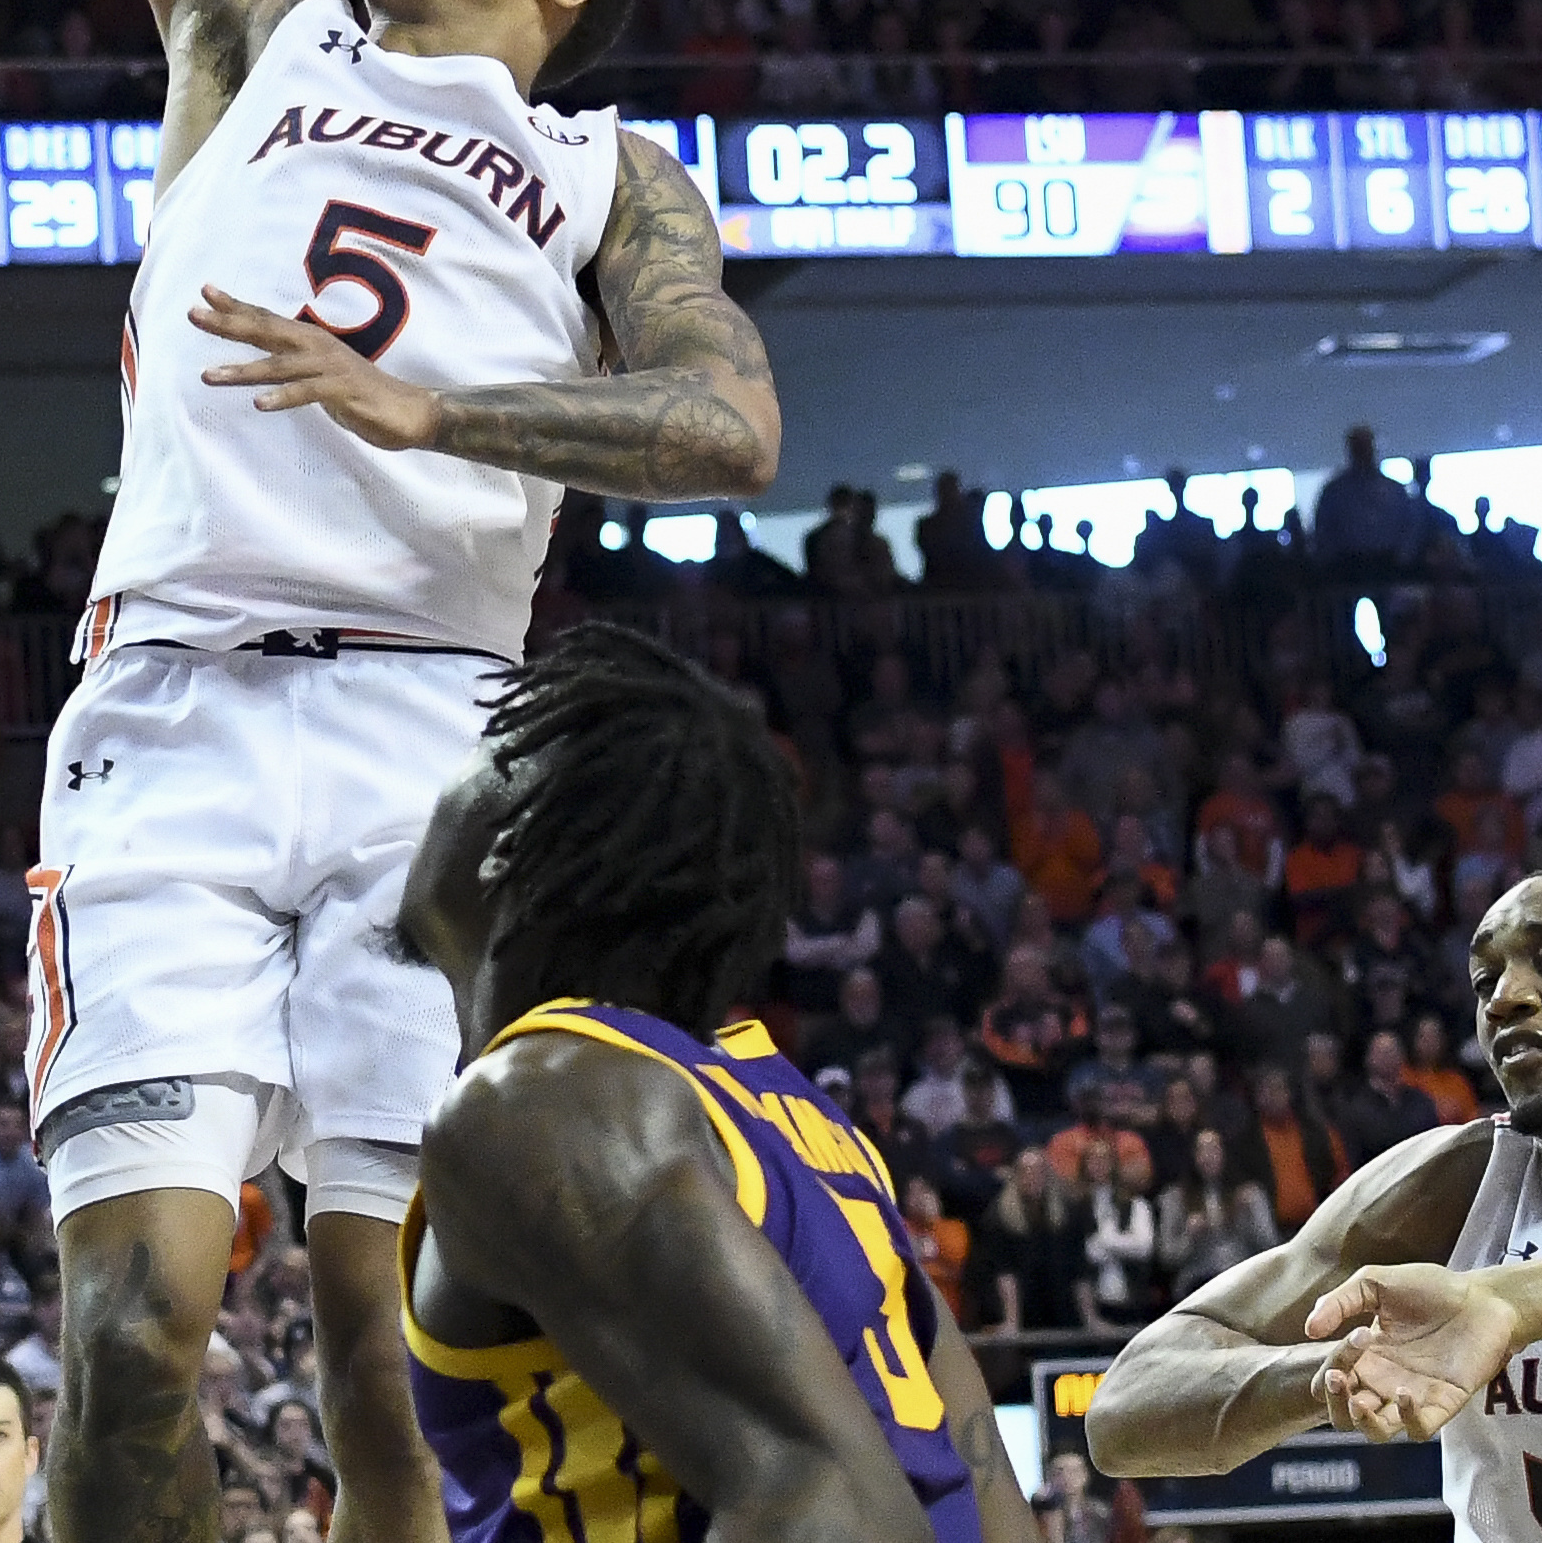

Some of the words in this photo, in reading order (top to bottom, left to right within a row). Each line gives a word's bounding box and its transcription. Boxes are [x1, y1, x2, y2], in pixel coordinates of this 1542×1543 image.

[248, 104, 567, 250] AUBURN
[746, 122, 918, 206] 02.2
[1266, 168, 1315, 236] 2
[1364, 167, 1416, 235] 6
[8, 179, 98, 249] 29
[994, 179, 1078, 241] 90
[296, 198, 438, 363] 5
